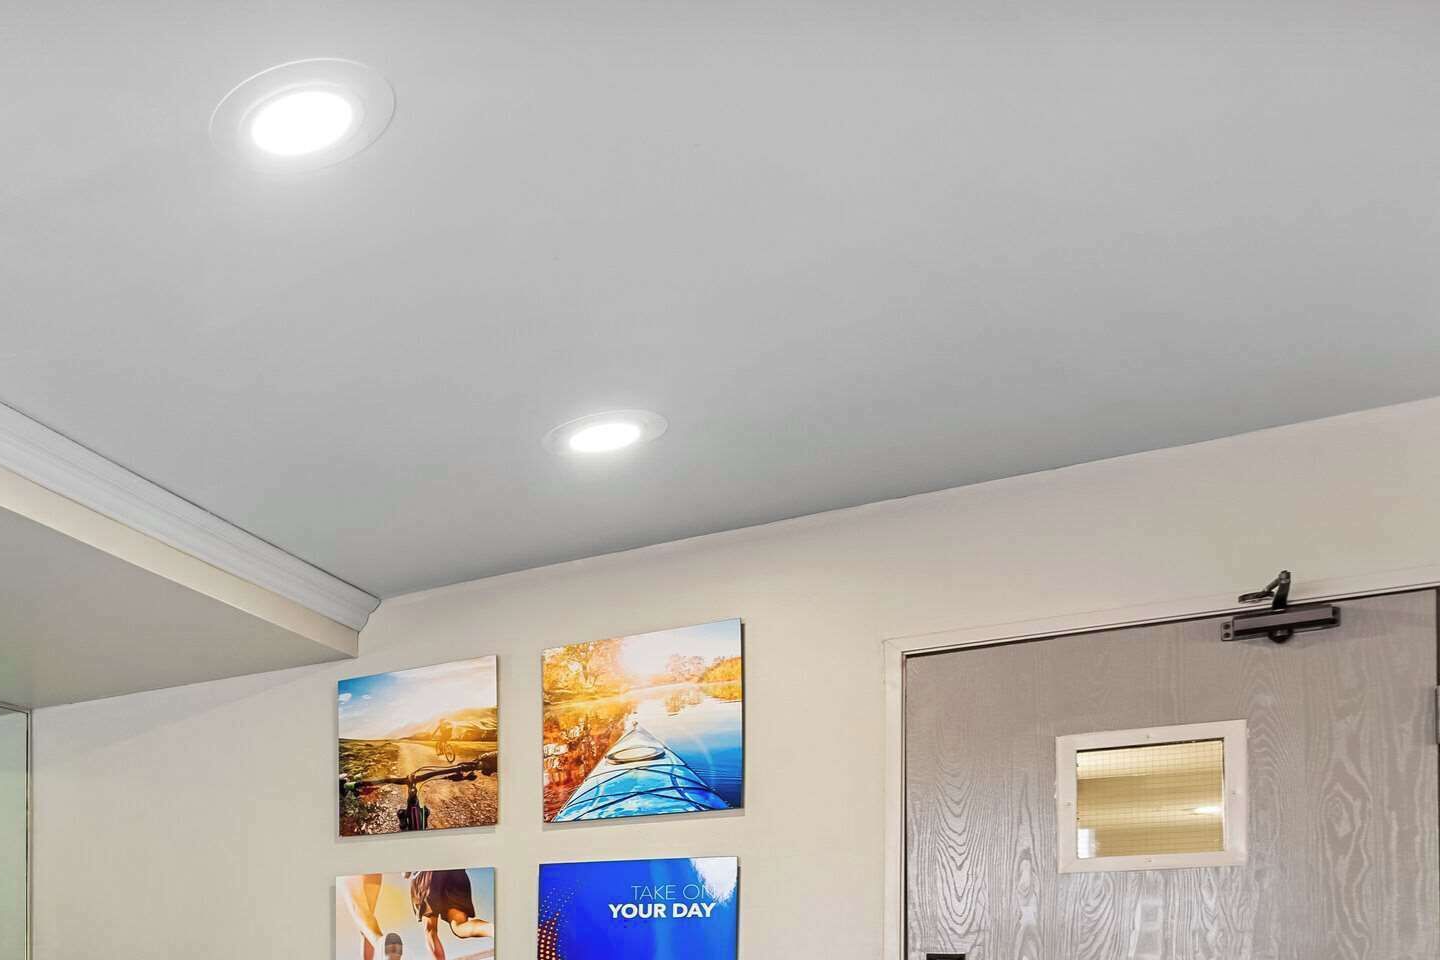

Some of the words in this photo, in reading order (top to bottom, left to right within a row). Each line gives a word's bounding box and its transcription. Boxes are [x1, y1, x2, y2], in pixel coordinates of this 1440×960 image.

[632, 884, 677, 900] TAKE
[608, 903, 667, 919] YOUR
[672, 902, 717, 918] DAY
